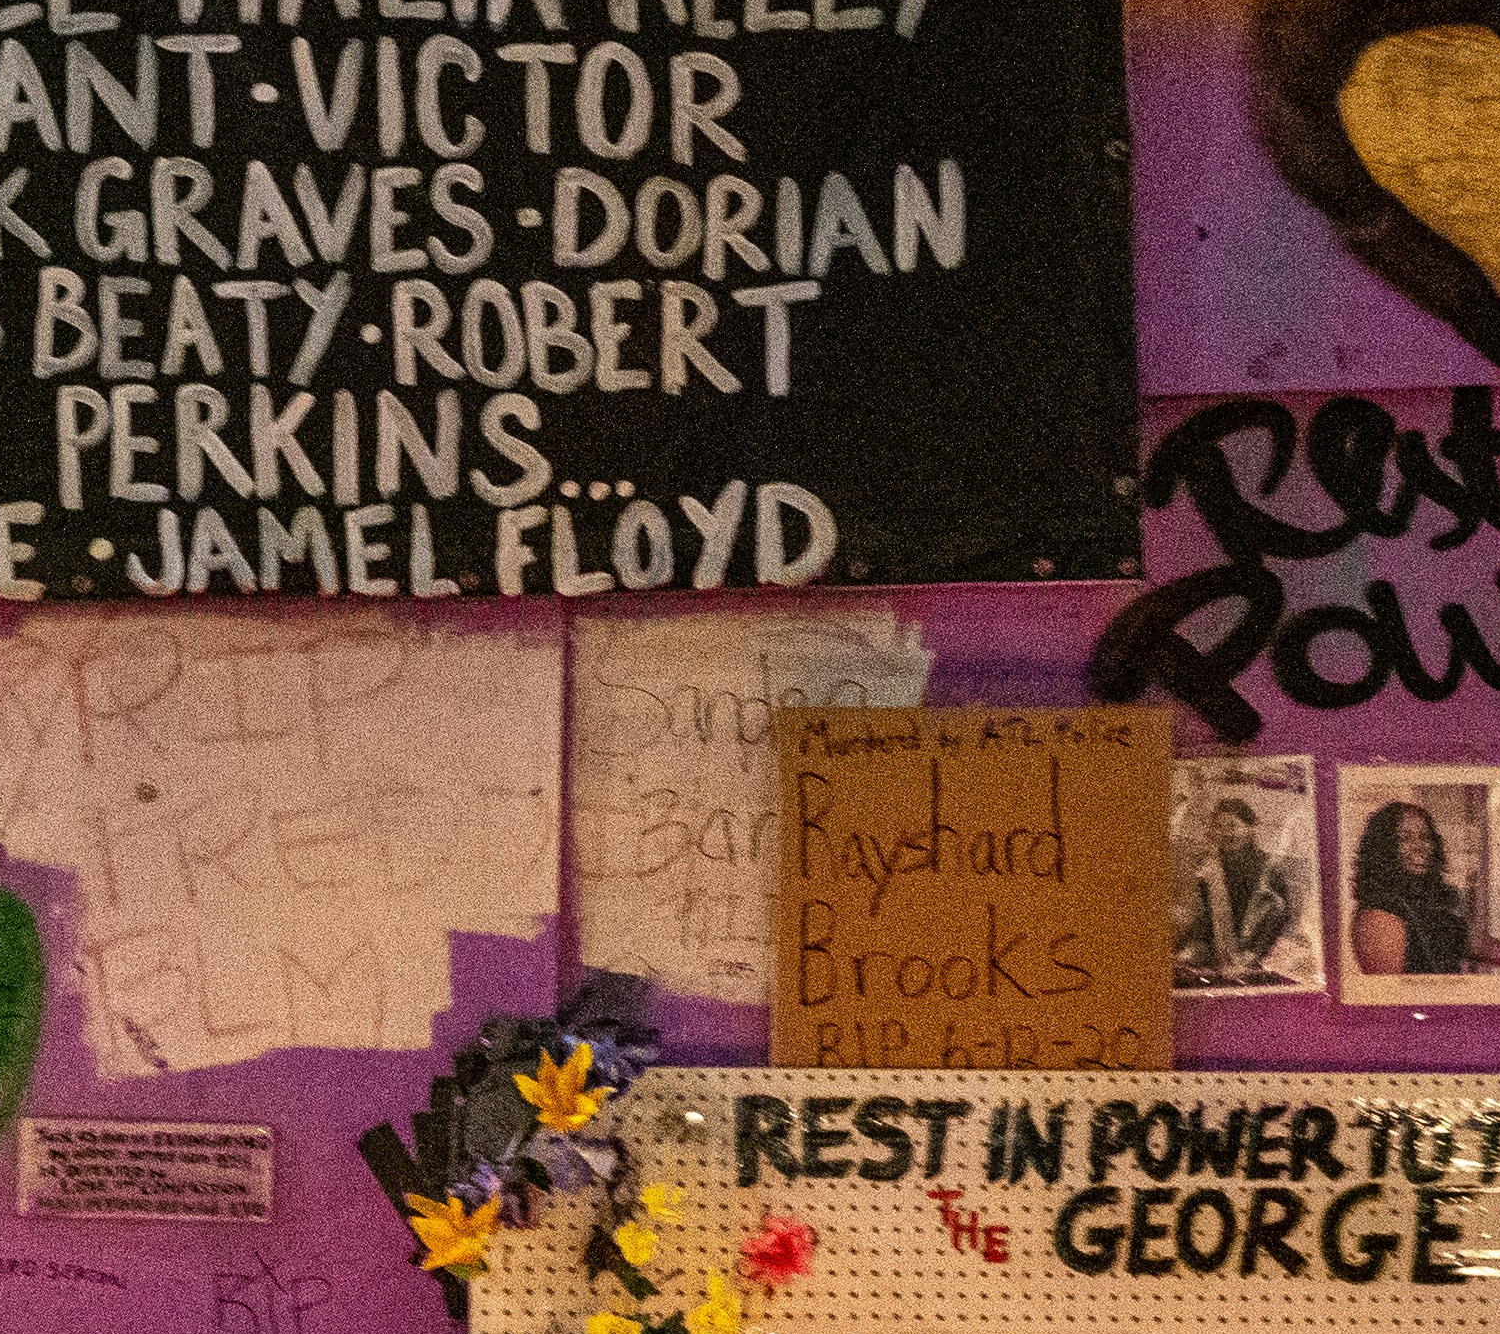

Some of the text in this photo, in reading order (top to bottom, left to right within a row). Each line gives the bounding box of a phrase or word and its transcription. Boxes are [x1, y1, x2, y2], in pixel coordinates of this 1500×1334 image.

[293, 34, 751, 165] VICTOR
[76, 155, 495, 272] GRAVES
[552, 159, 966, 276] DORIAN
[34, 266, 351, 385] BEATY
[394, 278, 822, 397] ROBERT
[125, 503, 461, 600] JAMEL
[495, 479, 839, 600] FLOYD
[800, 755, 1066, 917] Rayshard
[736, 1096, 968, 1188] REST
[988, 1101, 1070, 1185] IN
[1090, 1098, 1344, 1185] POWER
[1366, 1098, 1452, 1185] TO
[927, 1190, 1011, 1264] THE
[1054, 1185, 1471, 1286] GEORGE
